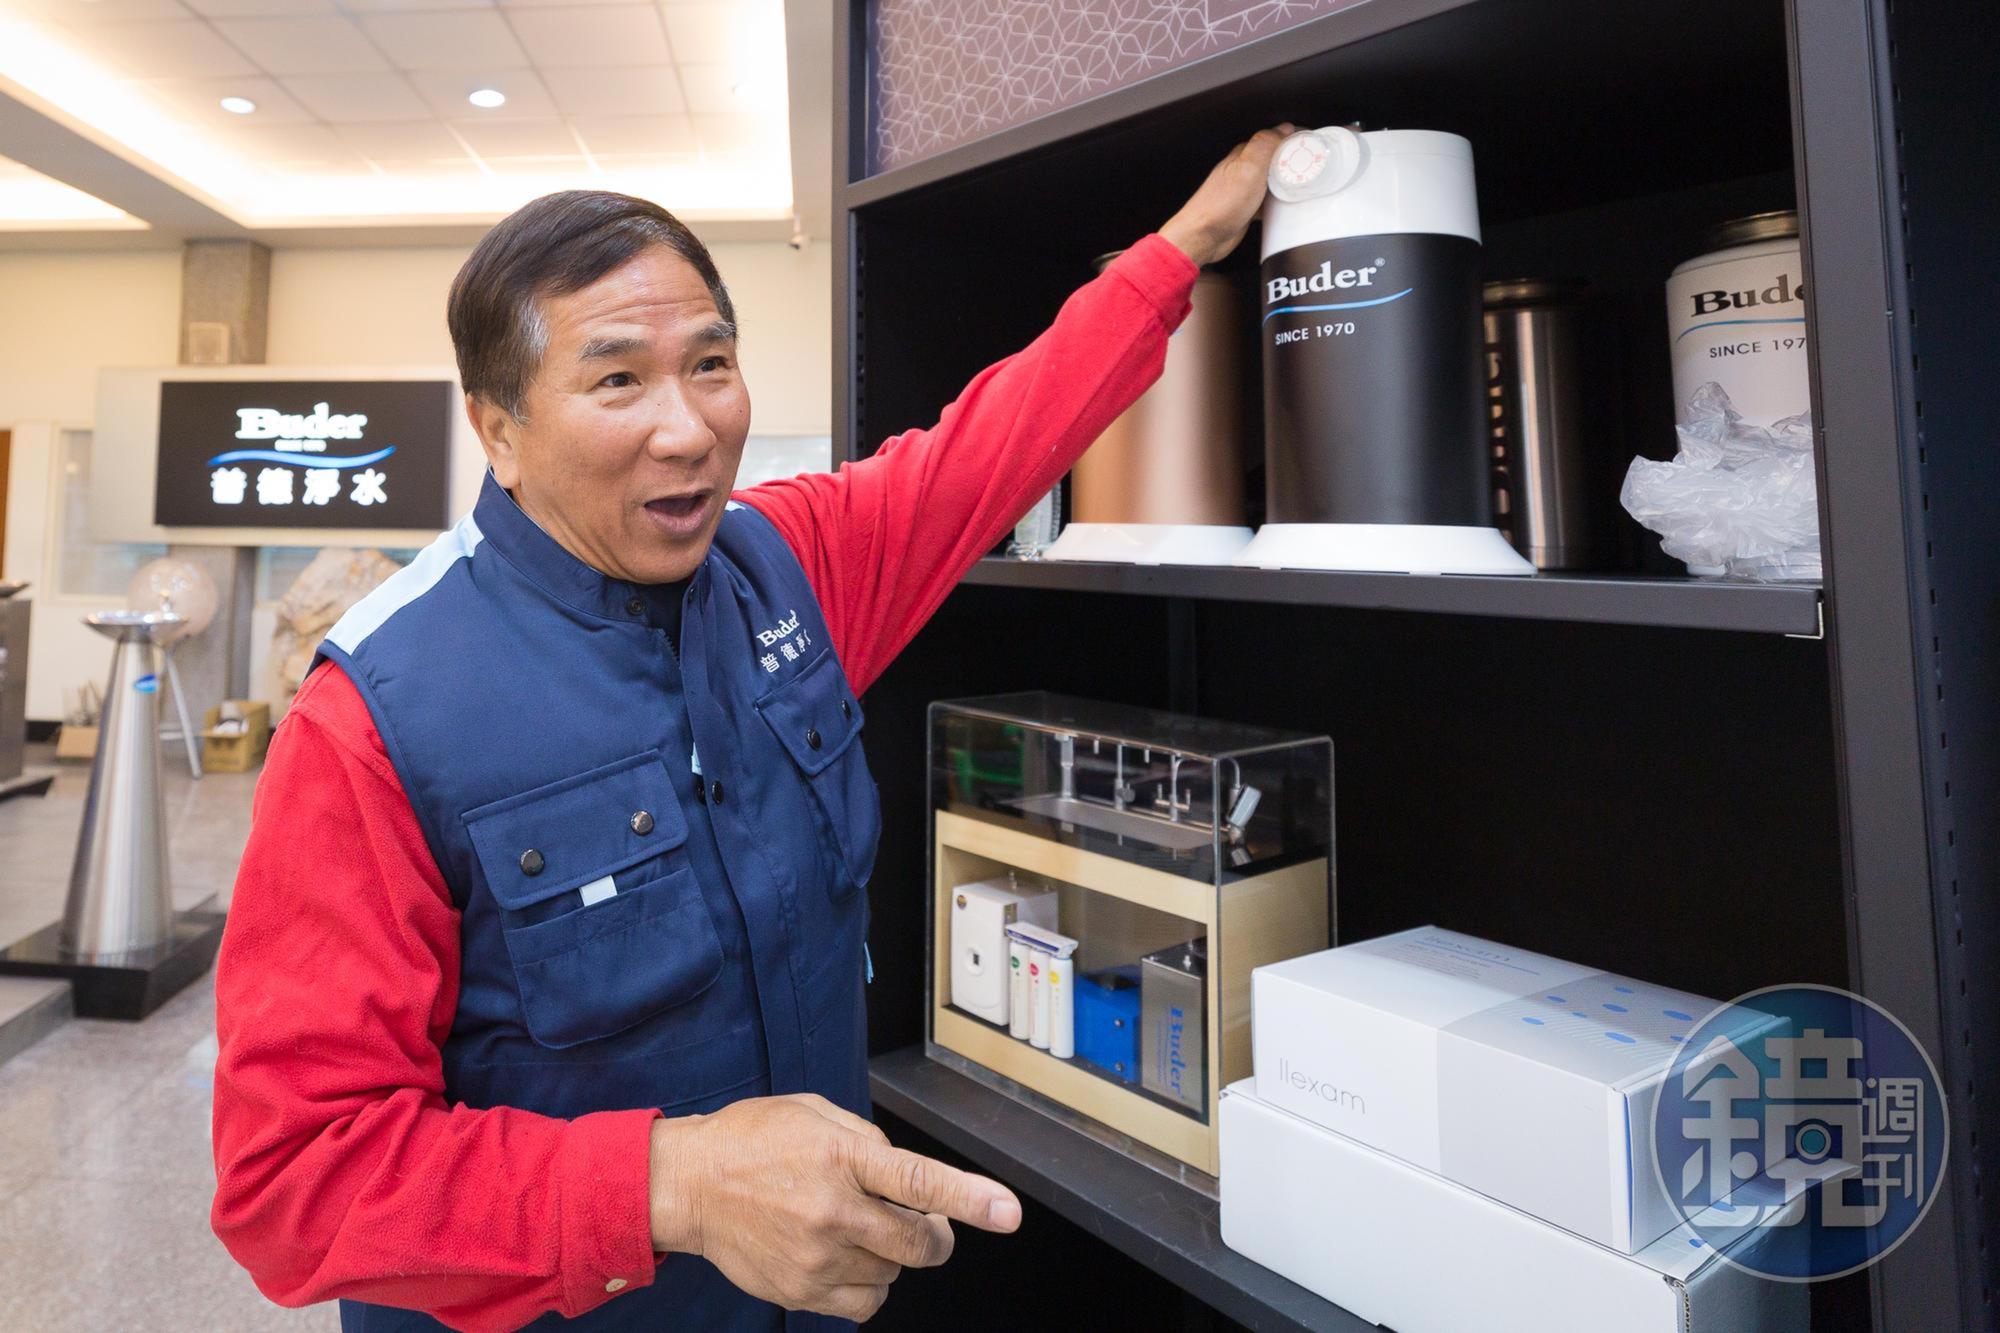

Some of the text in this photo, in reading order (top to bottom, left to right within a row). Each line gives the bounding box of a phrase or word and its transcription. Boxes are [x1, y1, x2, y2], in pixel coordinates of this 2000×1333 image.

[1275, 322, 1356, 346] SINCE 1970
[1709, 341, 1763, 359] SINCE
[235, 402, 368, 440] Buder
